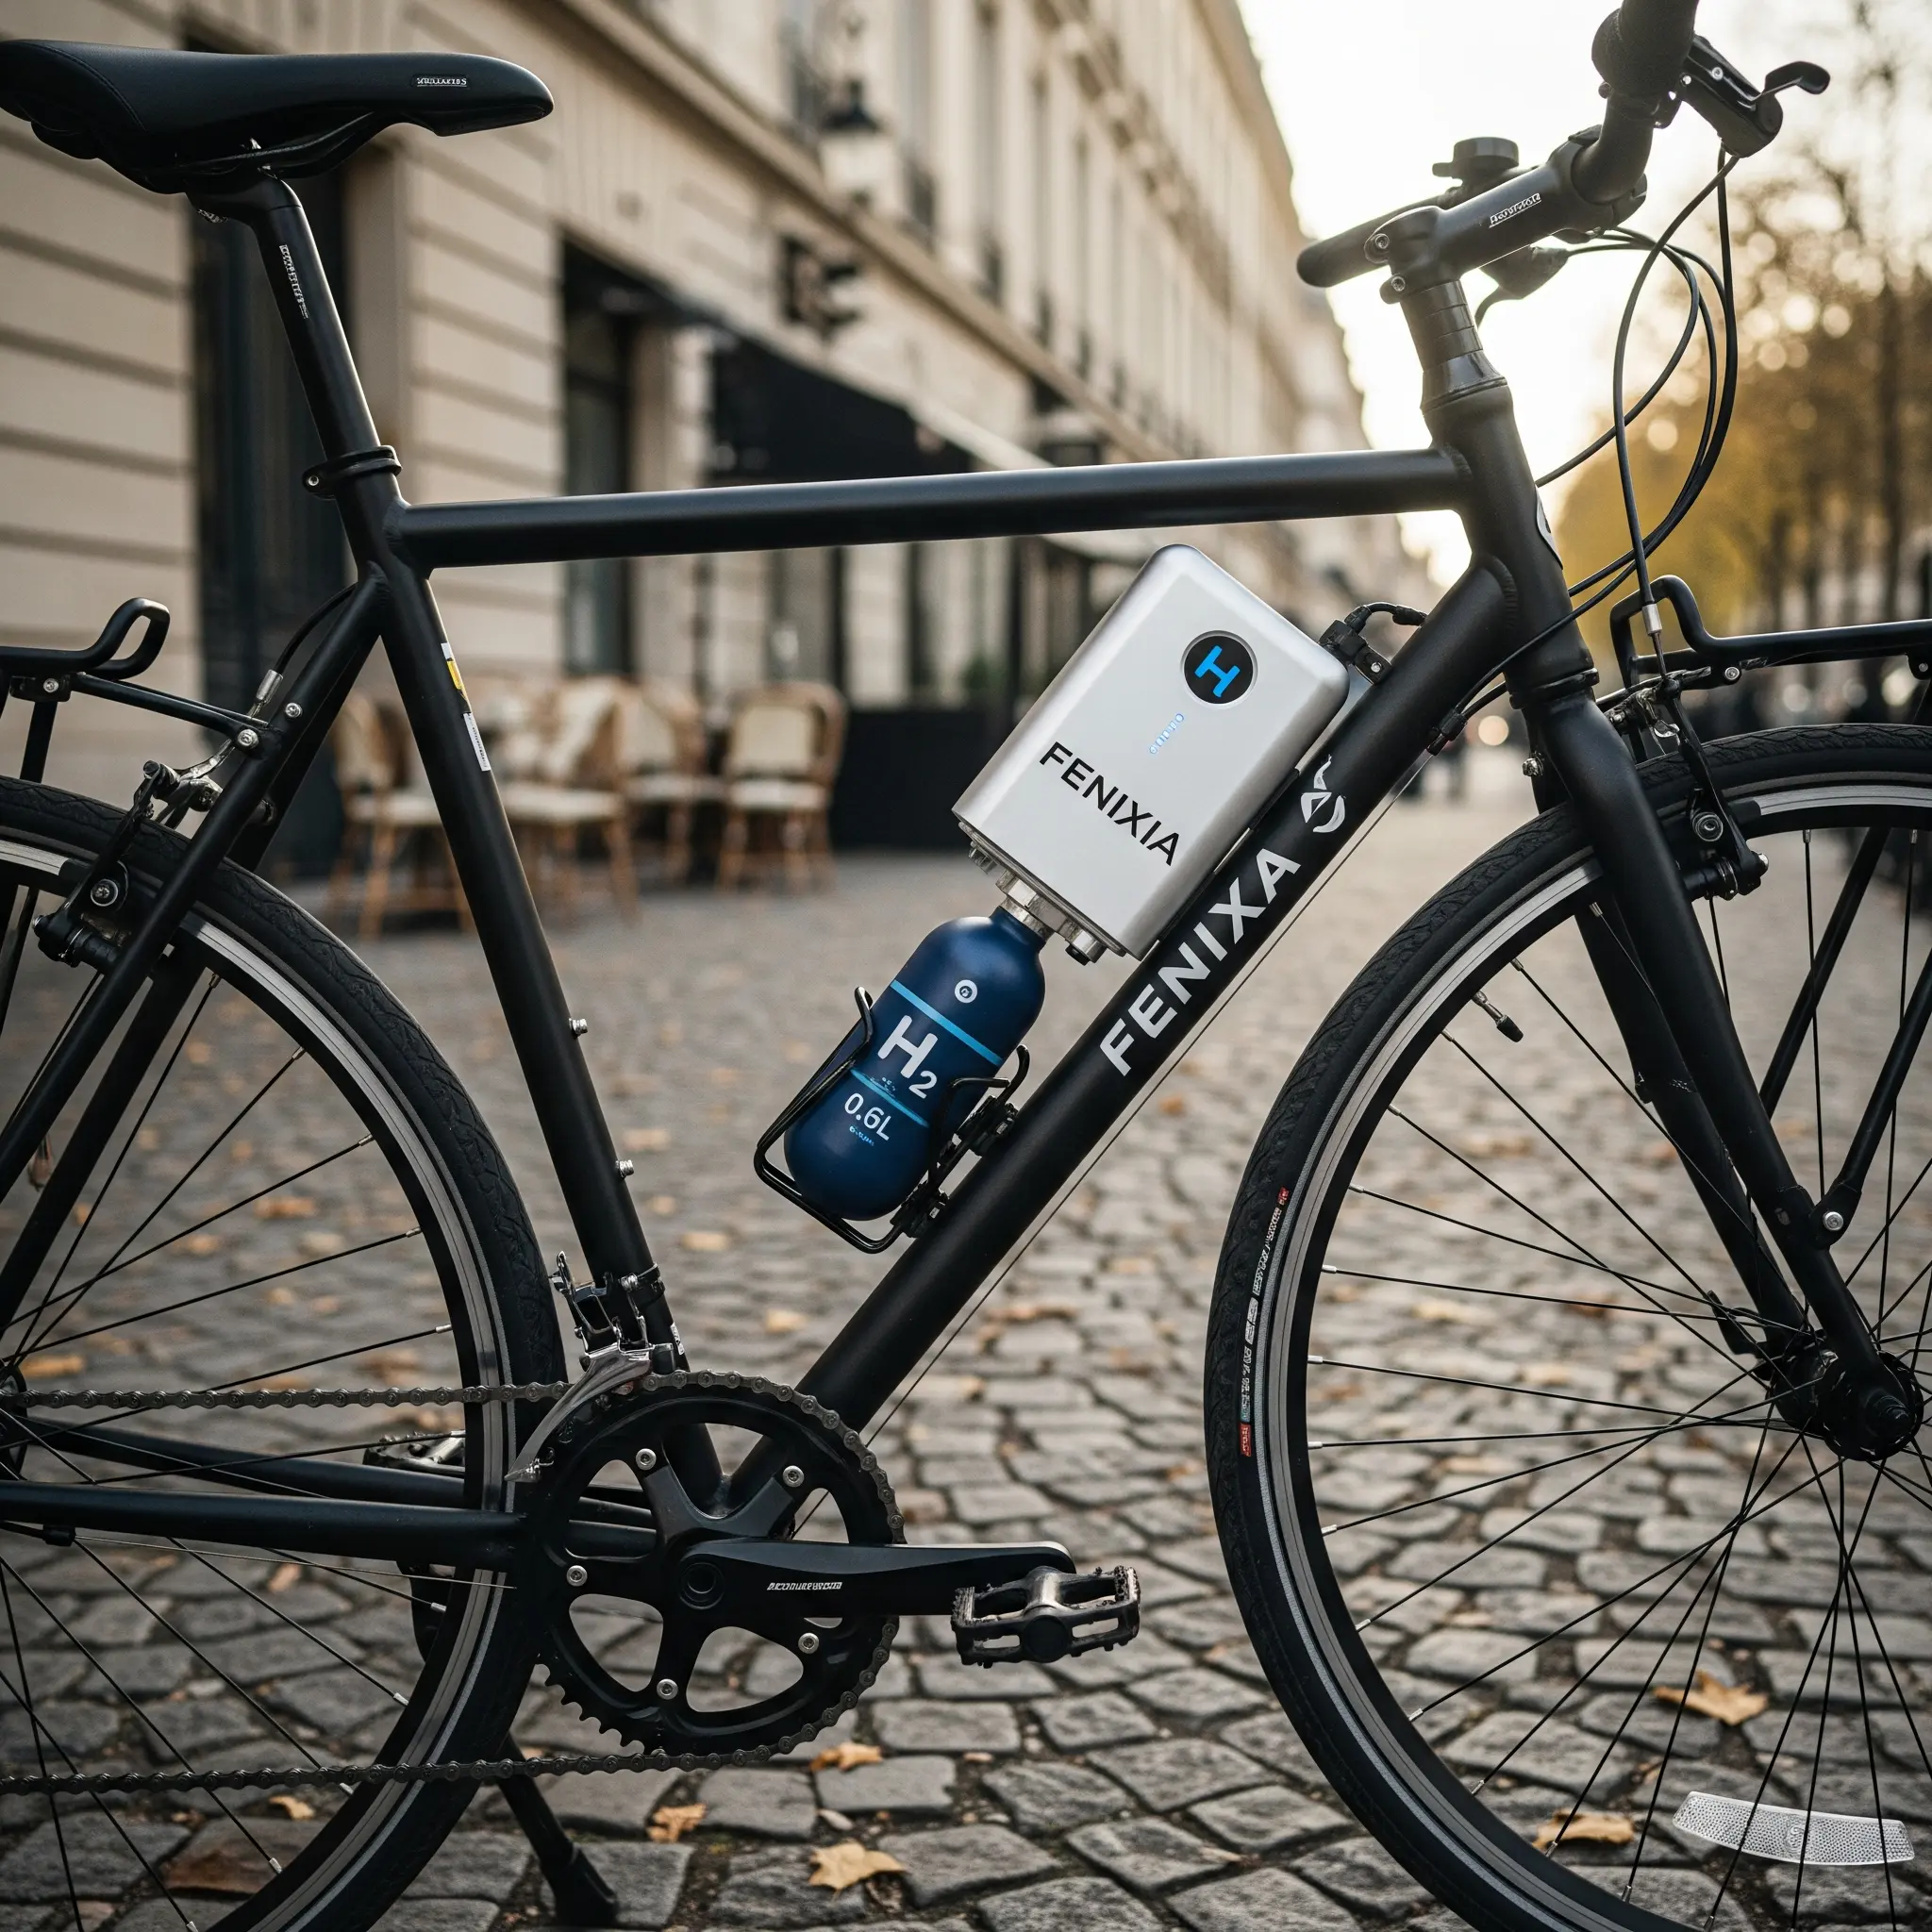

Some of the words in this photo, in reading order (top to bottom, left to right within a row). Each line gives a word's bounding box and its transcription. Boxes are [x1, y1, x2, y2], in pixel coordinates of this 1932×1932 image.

[1194, 644, 1241, 698] H
[1039, 741, 1179, 866] FENIXIA
[1099, 848, 1301, 1076] FENIXA
[844, 1092, 891, 1141] 0.6L
